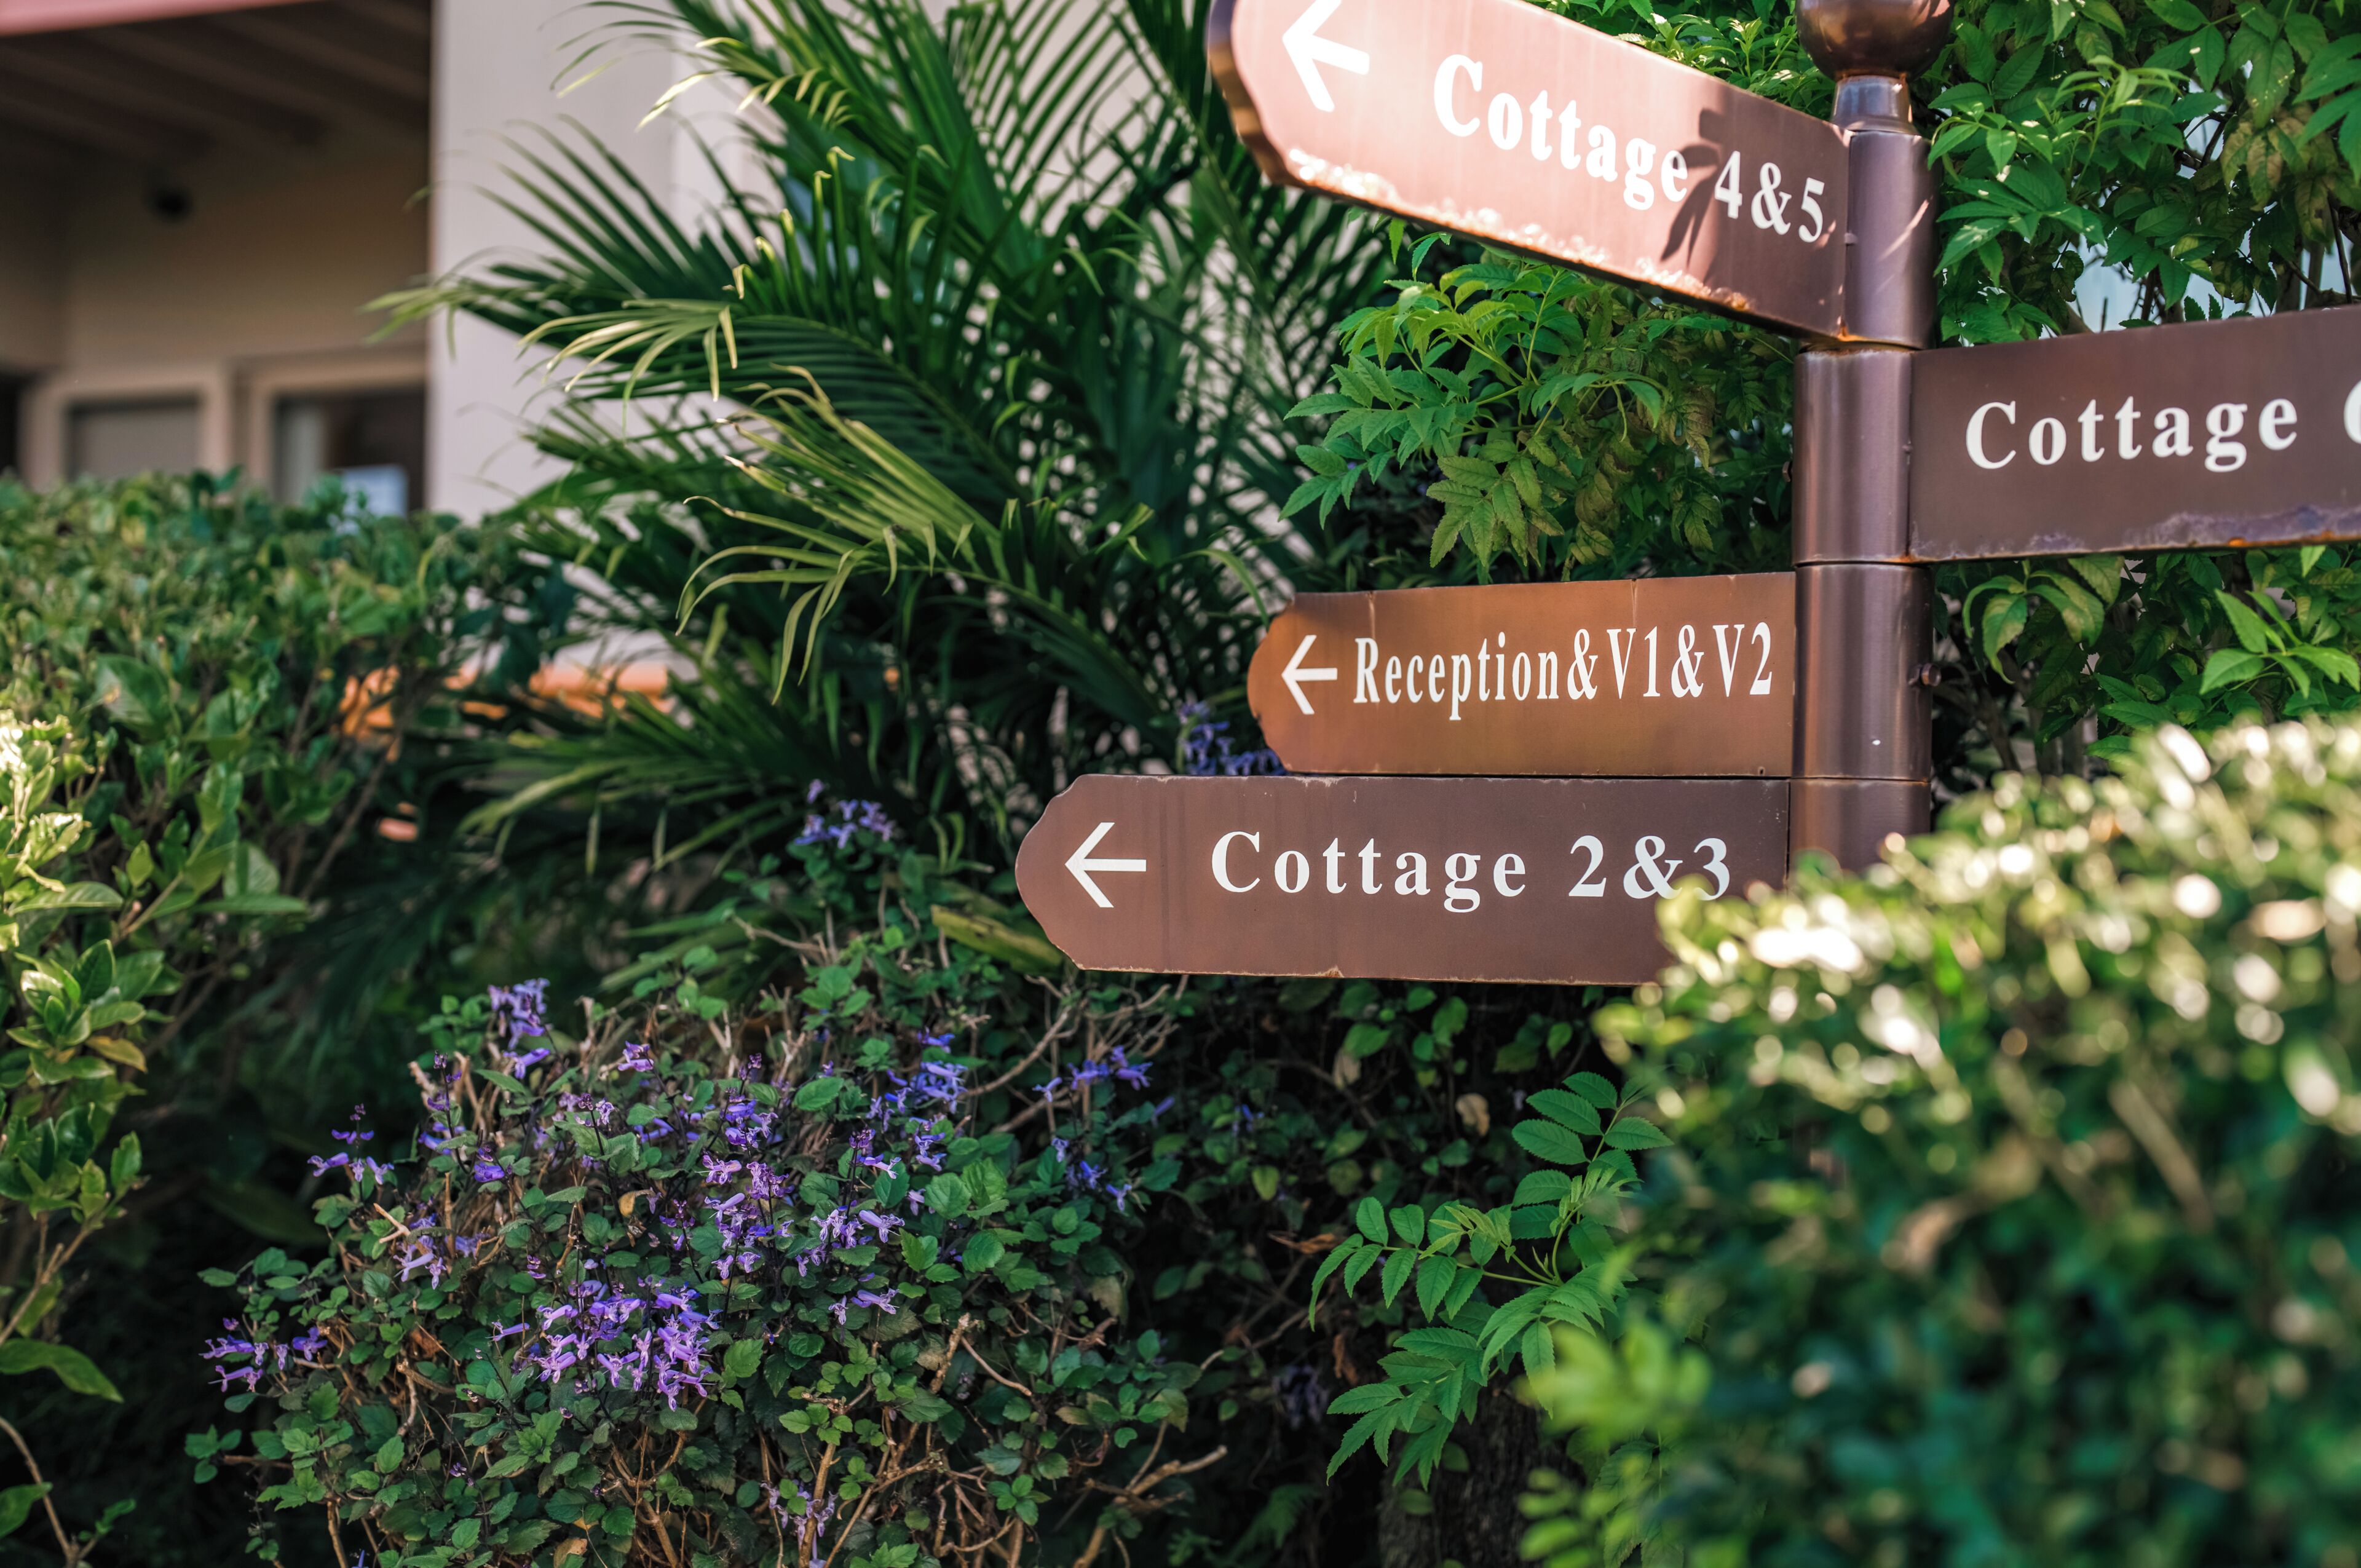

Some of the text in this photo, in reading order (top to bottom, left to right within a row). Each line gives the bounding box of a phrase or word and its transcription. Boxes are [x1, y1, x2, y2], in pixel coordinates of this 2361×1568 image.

[1433, 53, 1825, 243] Cottage 4&5
[1966, 395, 2298, 473] Cottage
[1211, 831, 1731, 913] Cottage 2&3
